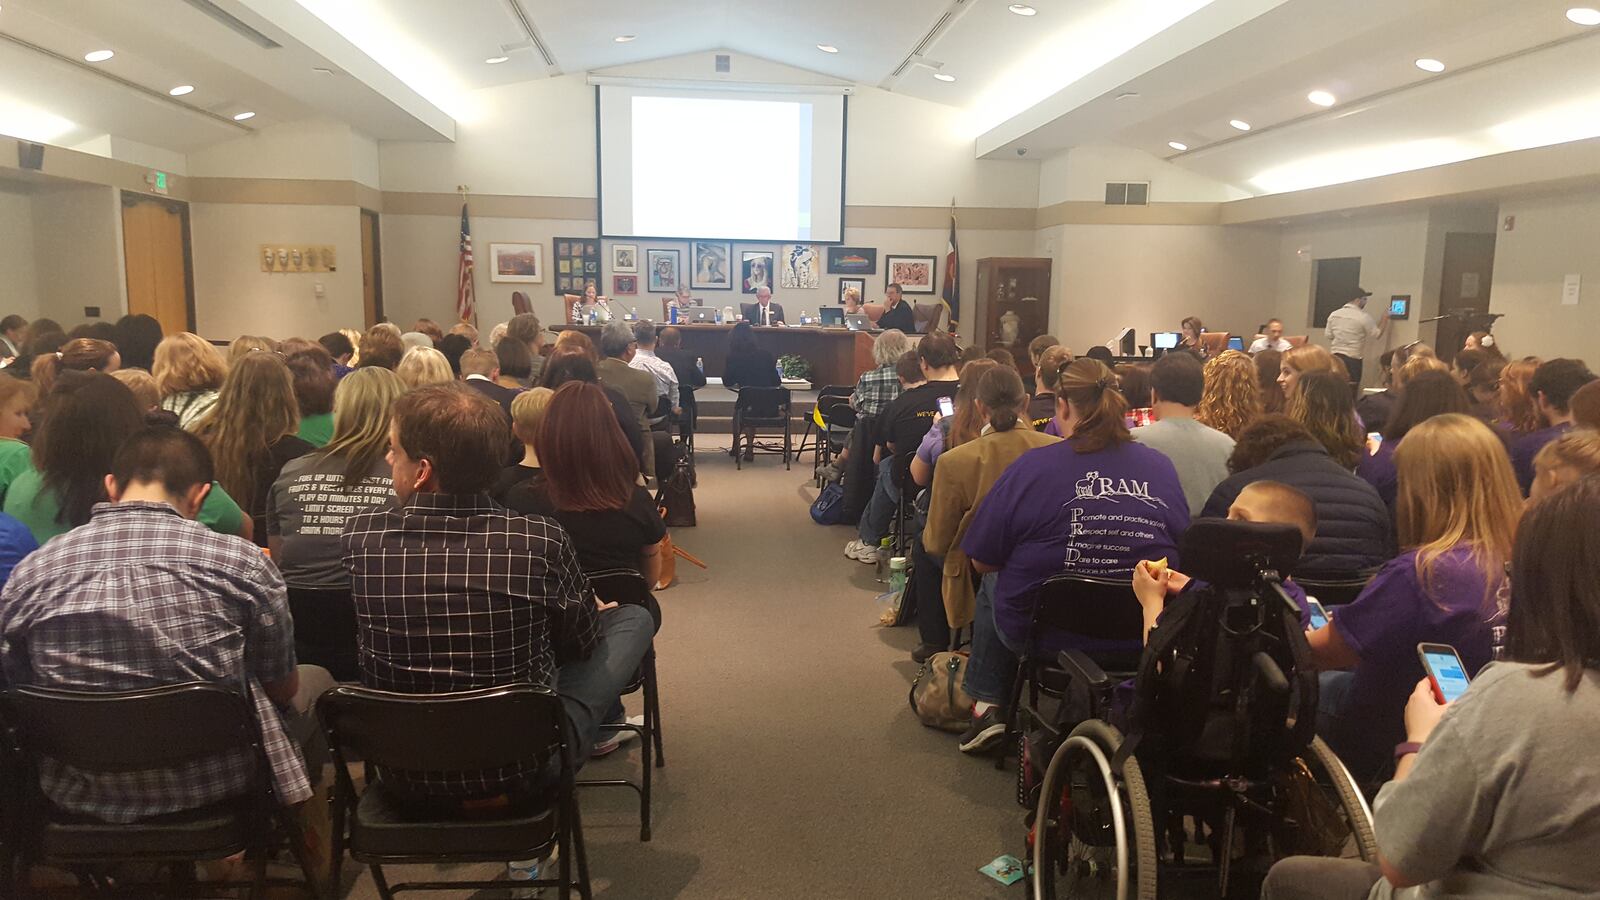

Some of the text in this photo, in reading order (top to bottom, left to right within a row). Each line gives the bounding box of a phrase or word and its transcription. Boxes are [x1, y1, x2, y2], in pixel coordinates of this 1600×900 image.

[288, 484, 310, 494] FRUITS
[364, 486, 387, 494] EVERY
[1098, 478, 1148, 499] RAM
[329, 494, 362, 502] MINUTES
[370, 496, 387, 505] DAY
[326, 505, 354, 513] SCREEN
[1070, 508, 1106, 522] Promote
[1124, 516, 1148, 524] practice
[302, 515, 312, 523] TO
[320, 516, 344, 524] HOURS
[1070, 522, 1107, 535] Respect
[1134, 531, 1154, 539] others
[1067, 534, 1130, 552] Imagine success
[1064, 548, 1091, 563] Dare
